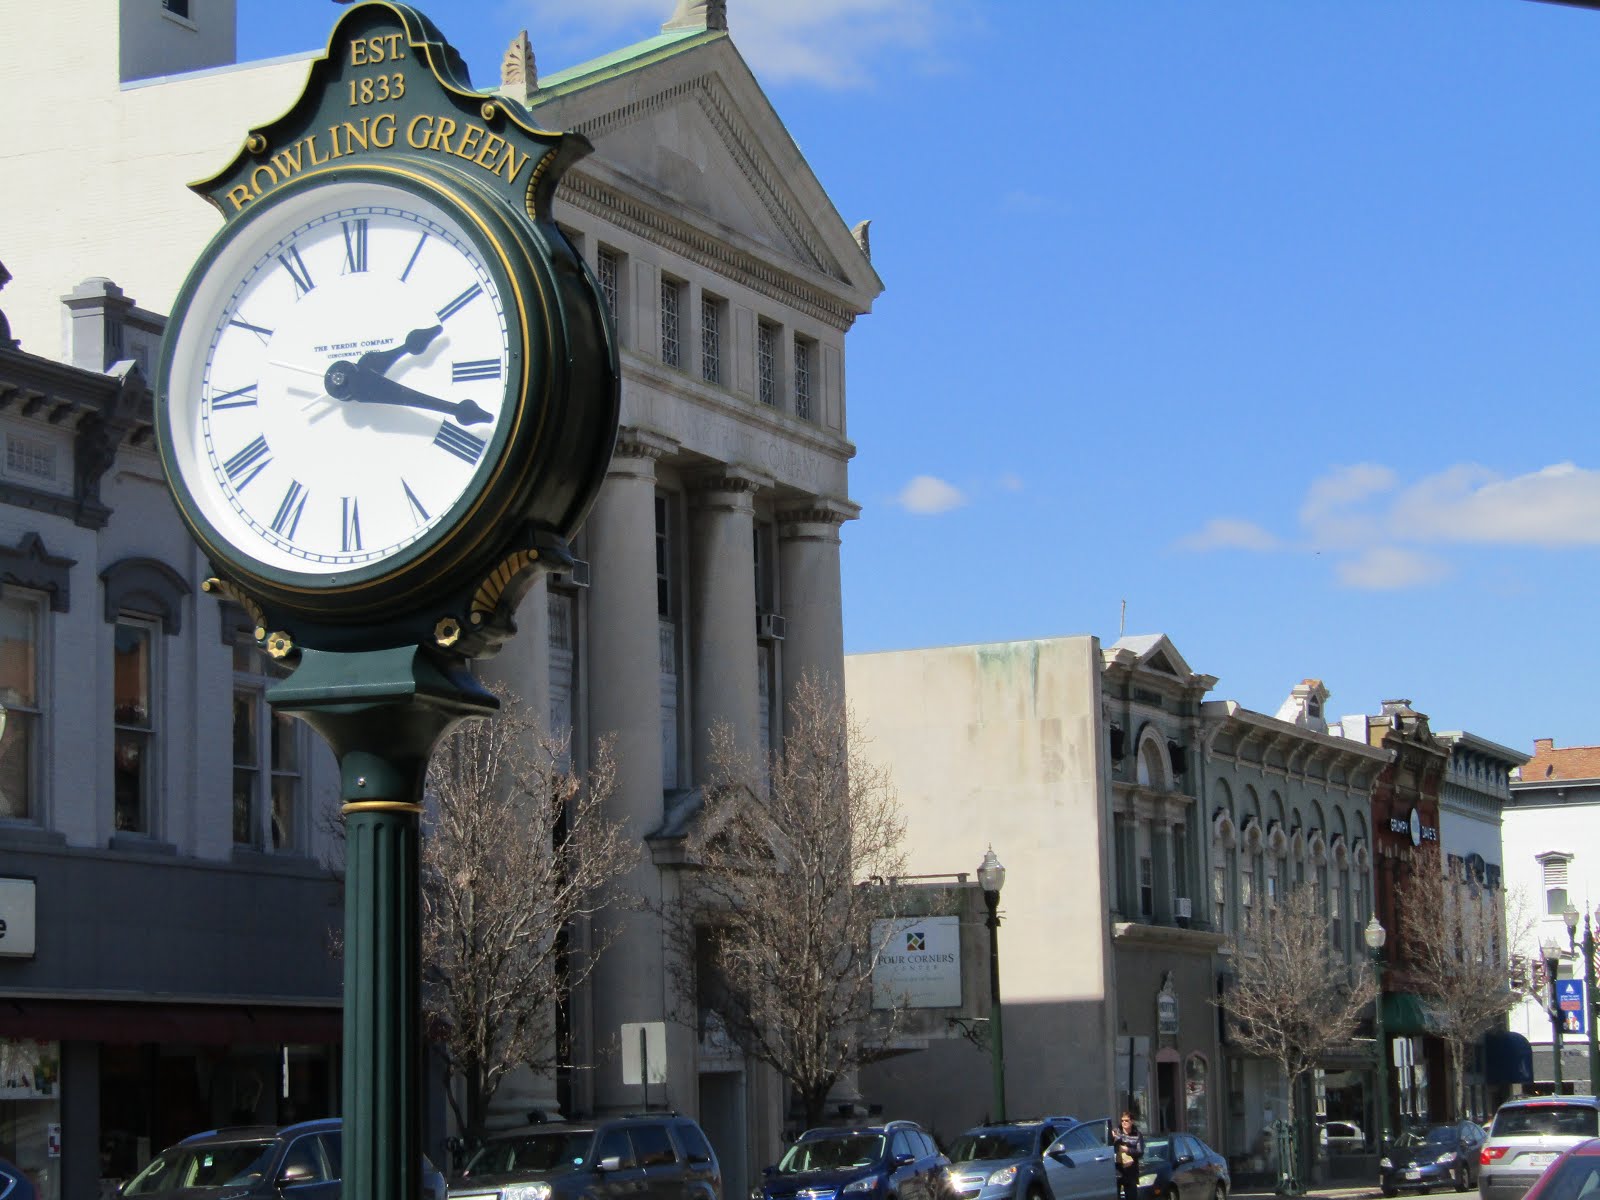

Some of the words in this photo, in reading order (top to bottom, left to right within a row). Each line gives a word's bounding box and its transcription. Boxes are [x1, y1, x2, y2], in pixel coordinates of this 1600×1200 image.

[350, 33, 405, 67] EST.
[348, 73, 405, 106] 1833
[225, 114, 397, 212] BOWLING
[406, 114, 531, 185] GREEN
[340, 218, 371, 276] XII
[331, 342, 358, 350] VERDIN
[361, 338, 394, 347] COMPANY
[452, 358, 501, 384] III
[878, 956, 905, 965] FOUR
[907, 953, 954, 964] CORNERS
